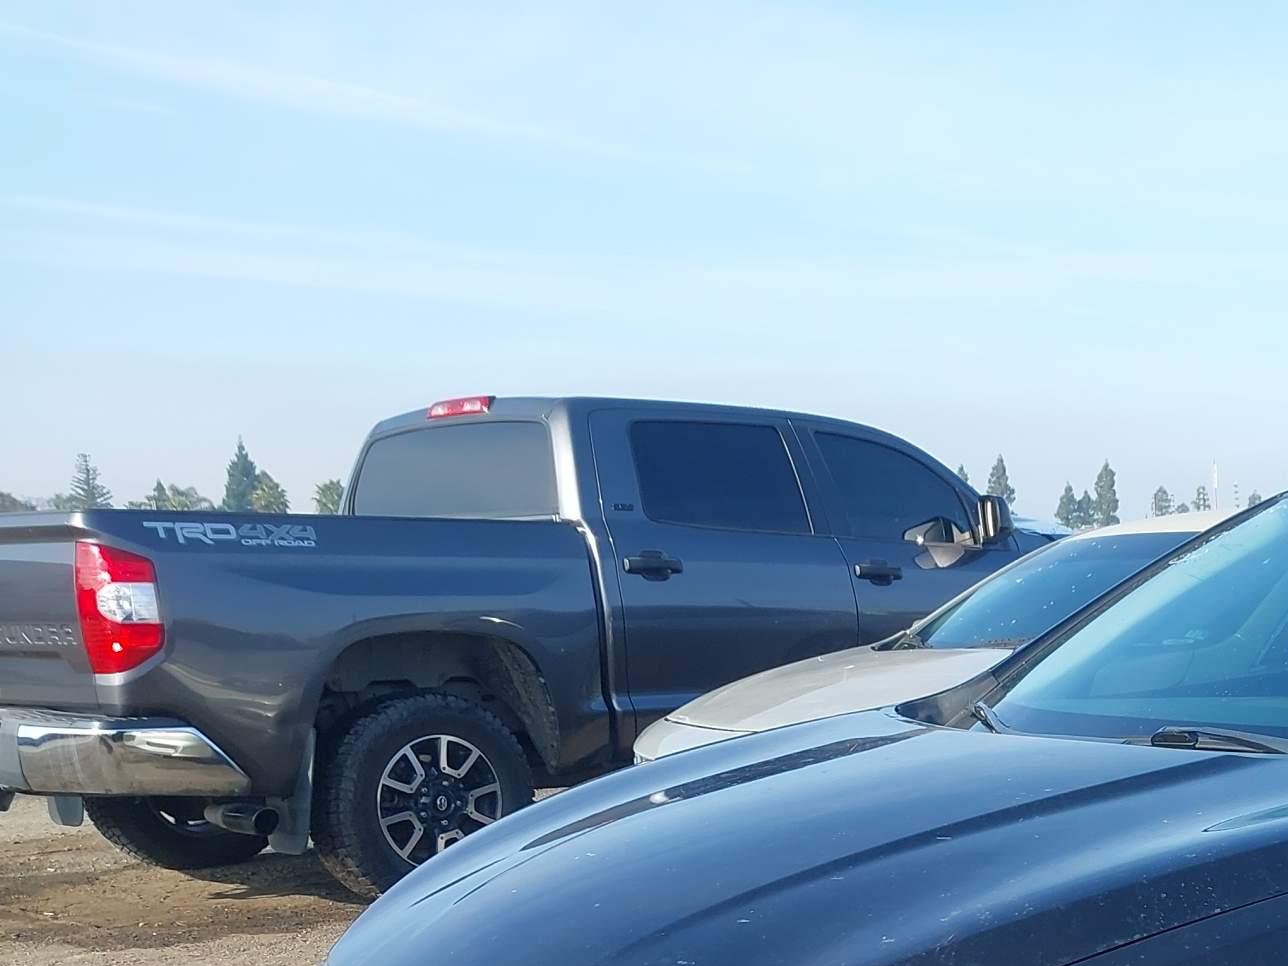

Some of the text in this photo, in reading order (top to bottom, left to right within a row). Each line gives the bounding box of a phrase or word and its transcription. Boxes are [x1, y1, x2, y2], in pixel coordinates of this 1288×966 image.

[143, 521, 237, 545] TRD
[241, 539, 317, 548] OFF ROAD
